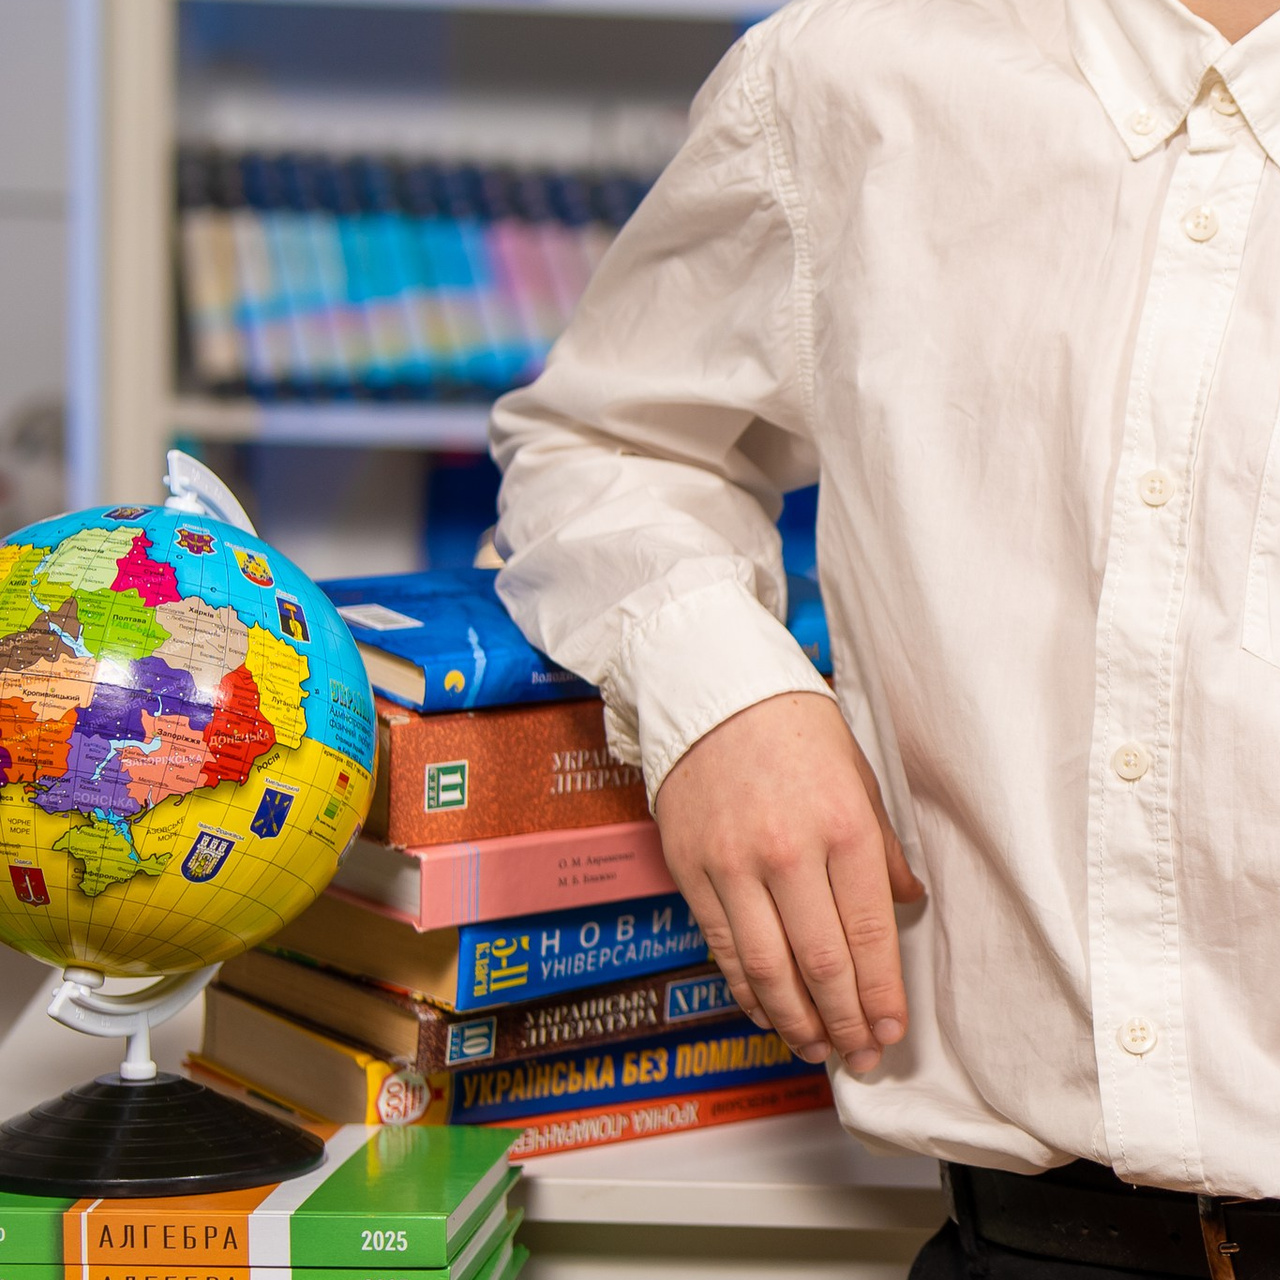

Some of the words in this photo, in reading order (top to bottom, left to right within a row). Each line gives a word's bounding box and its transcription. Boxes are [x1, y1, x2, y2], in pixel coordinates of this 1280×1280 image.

[113, 614, 147, 624] Полтава
[188, 607, 214, 619] Харків
[23, 689, 80, 701] Кропивницький
[156, 728, 201, 745] Запоріжжя
[256, 752, 281, 773] РОСІЯ
[7, 818, 31, 826] ЧОРНЕ
[10, 827, 30, 835] МОРЕ
[463, 1059, 614, 1109] УКРАЇНСЬКА
[622, 1047, 669, 1086] БЕЗ
[100, 1225, 237, 1249] АЛГЕБРА
[362, 1231, 407, 1251] 2025
